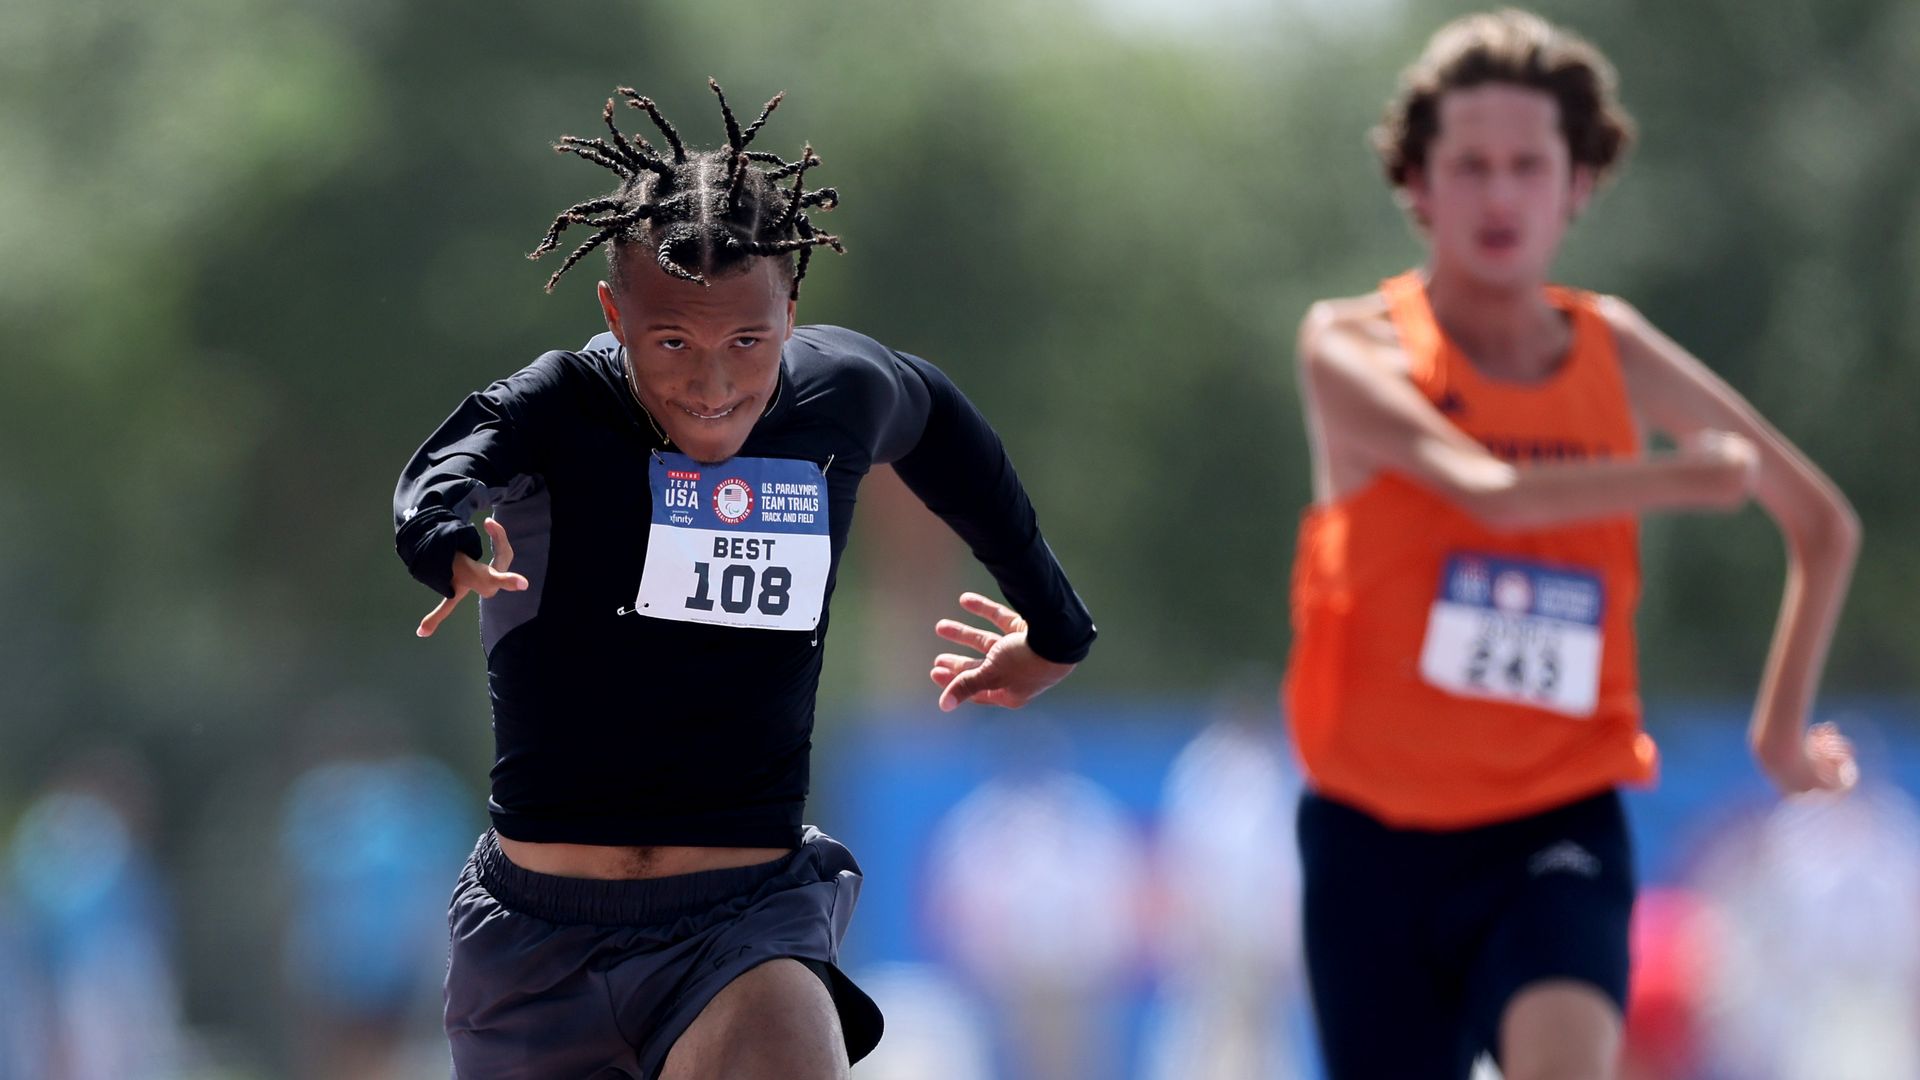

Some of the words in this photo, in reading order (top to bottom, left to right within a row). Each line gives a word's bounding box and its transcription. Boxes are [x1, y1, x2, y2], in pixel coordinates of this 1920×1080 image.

[670, 479, 697, 489] TEAM
[761, 483, 774, 494] U.S.
[775, 483, 818, 496] PARALYMPIC
[665, 488, 699, 510] USA
[761, 496, 786, 511] TEAM
[787, 497, 819, 512] TRIALS
[761, 512, 781, 523] TRACK
[782, 513, 797, 523] AND
[798, 513, 814, 524] FIELD
[713, 536, 776, 561] BEST
[684, 561, 792, 616] 108
